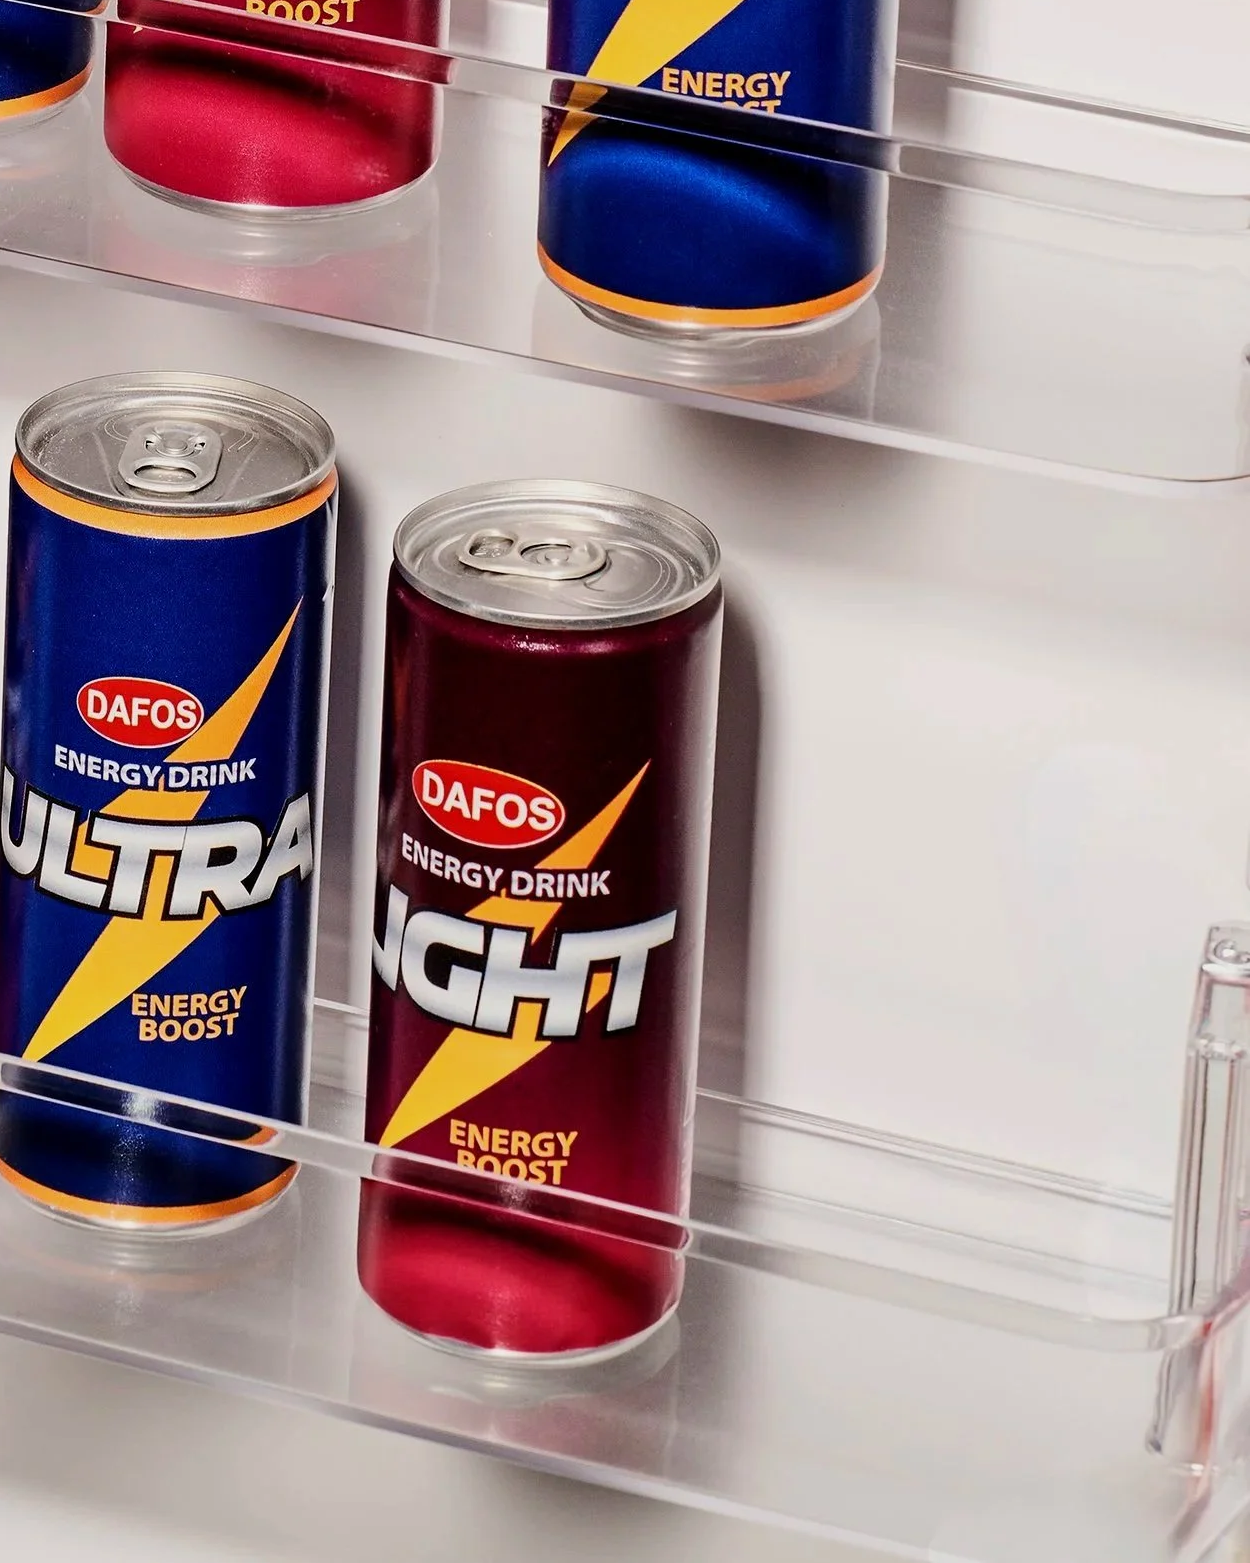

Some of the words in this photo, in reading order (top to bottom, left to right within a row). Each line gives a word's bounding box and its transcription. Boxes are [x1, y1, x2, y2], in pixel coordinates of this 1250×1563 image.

[662, 67, 791, 98] ENERGY
[86, 689, 198, 731] DAFOS
[53, 743, 162, 788] ENERGY
[168, 757, 257, 788] DRINK
[421, 768, 556, 833] DAFOS
[1, 765, 315, 916] ULTRA
[401, 832, 504, 892] ENERGY
[510, 868, 611, 899] DRINK
[131, 985, 248, 1018] ENERGY
[138, 1012, 240, 1043] BOOST
[449, 1118, 578, 1157] ENERGY
